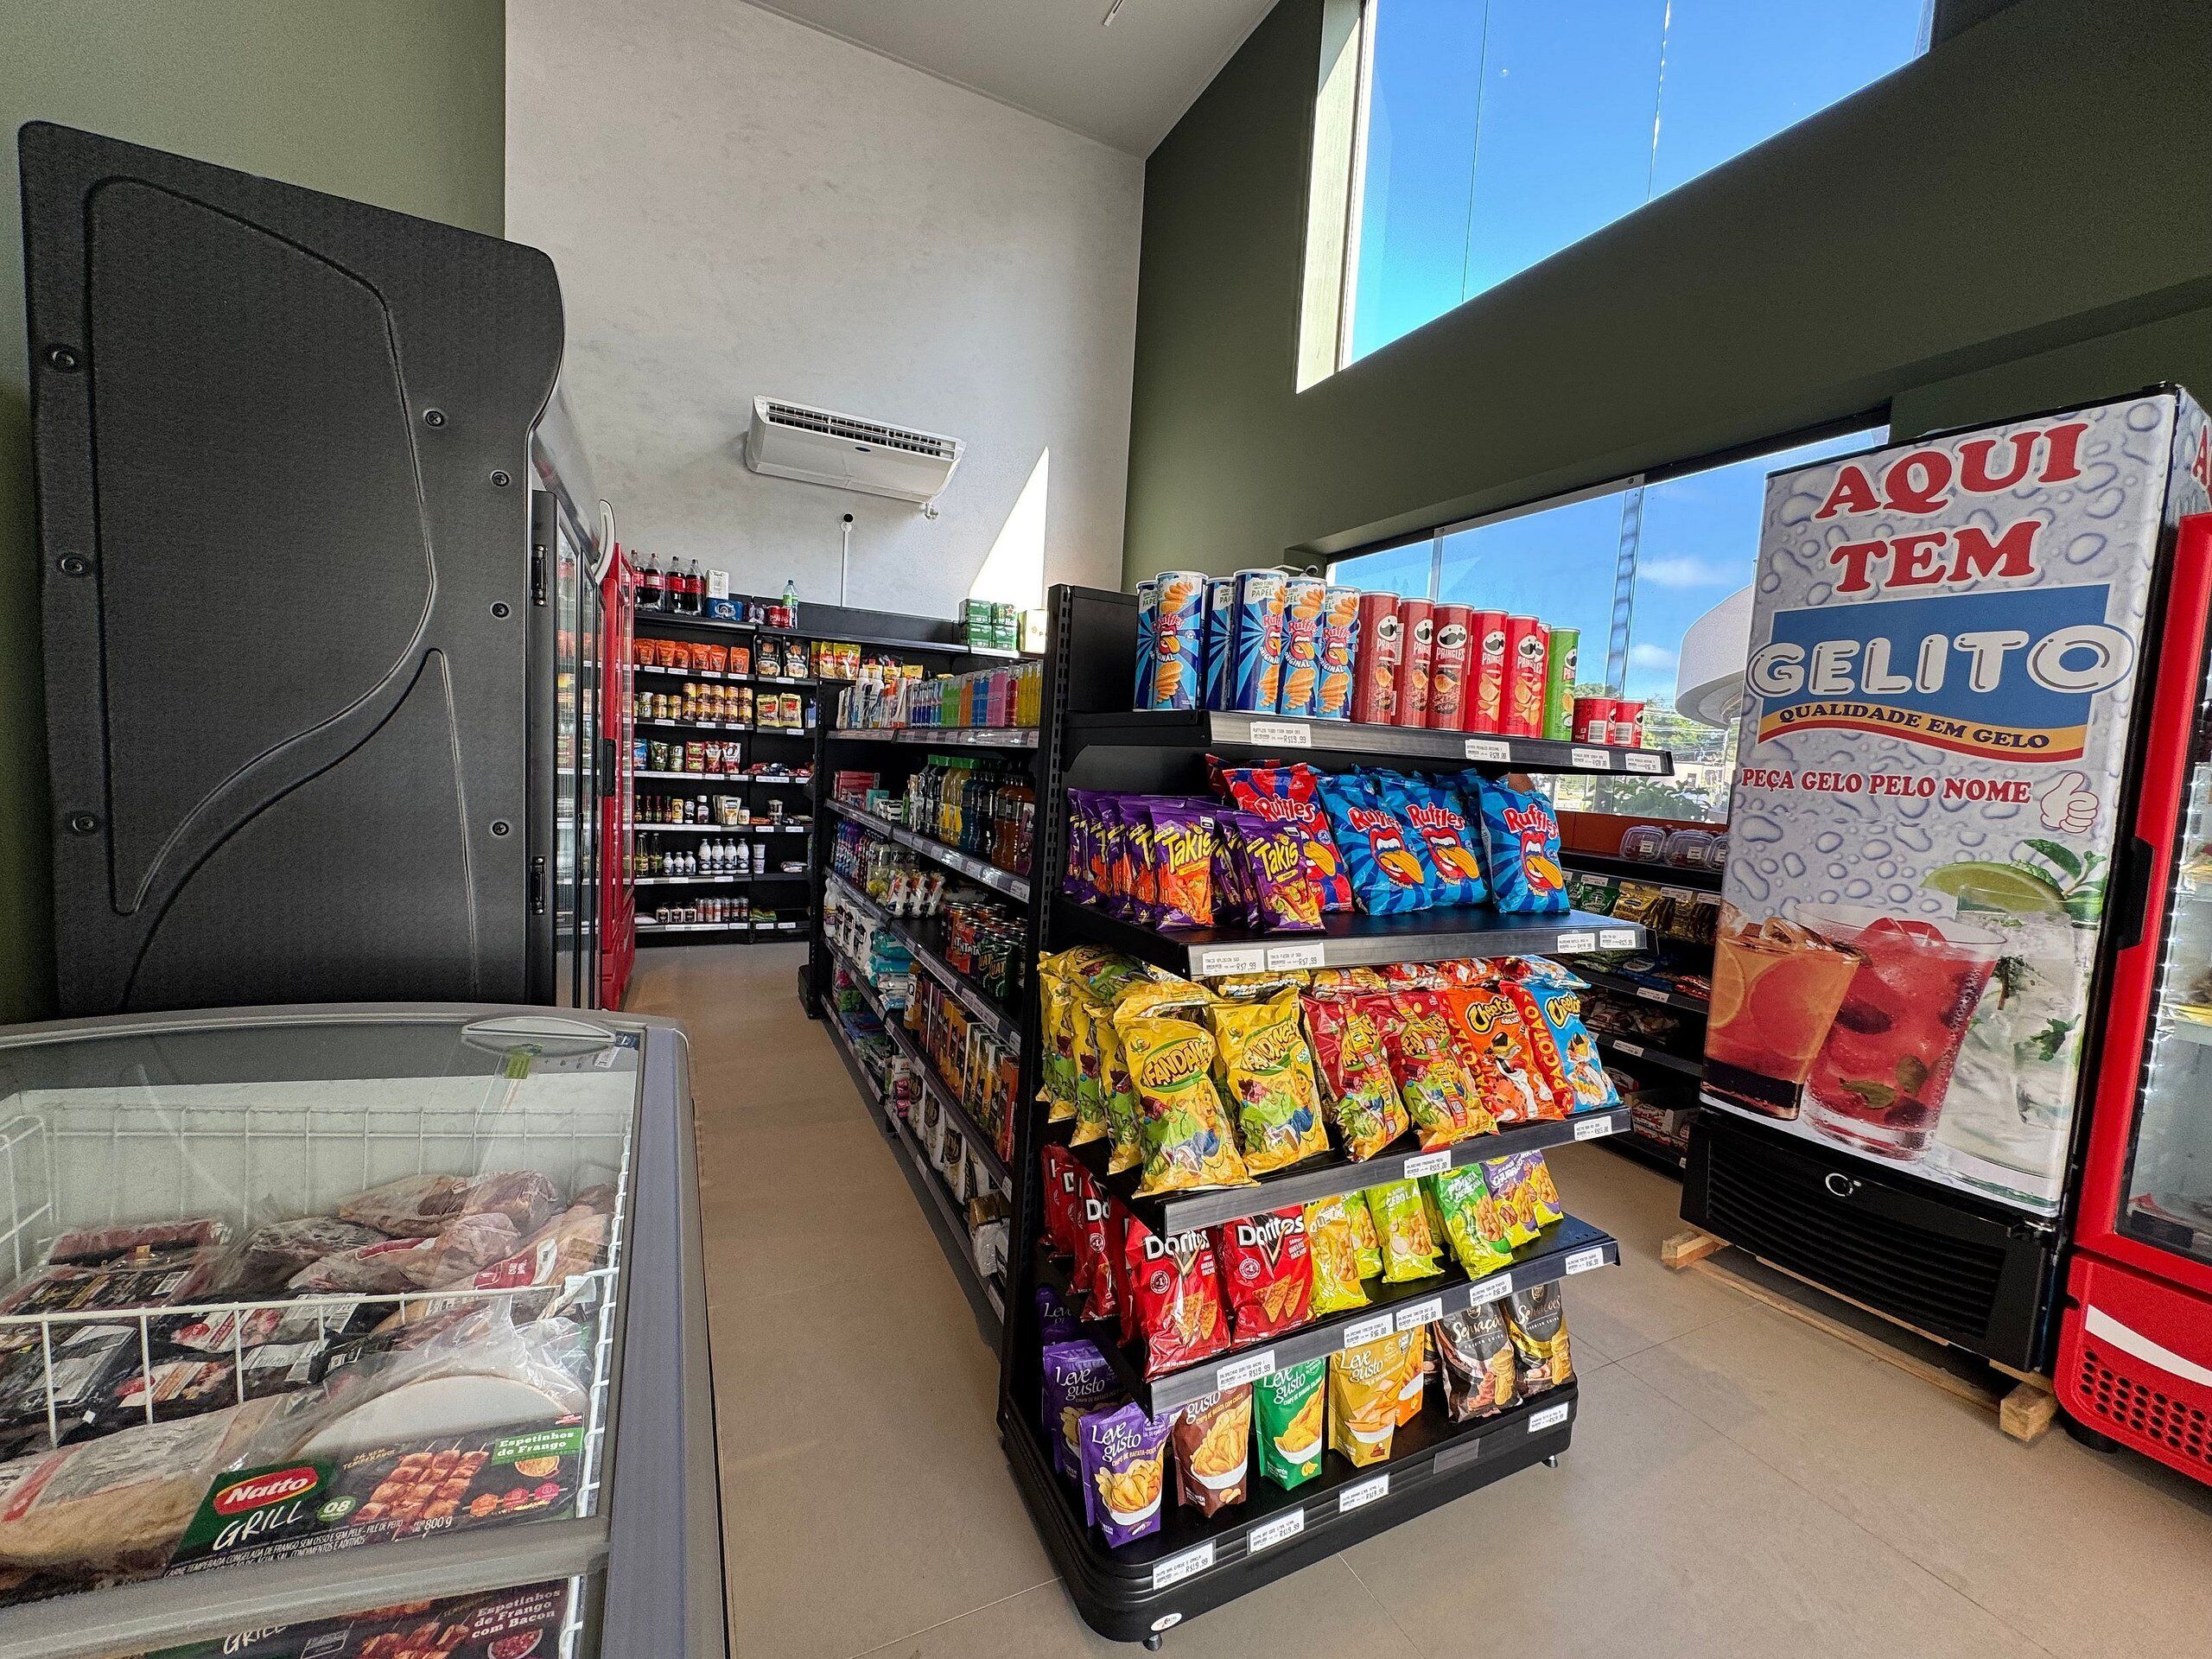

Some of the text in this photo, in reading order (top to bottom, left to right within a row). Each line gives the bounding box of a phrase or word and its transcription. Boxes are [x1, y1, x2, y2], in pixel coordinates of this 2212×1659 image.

[1815, 423, 2088, 519] AQUI
[1829, 520, 2042, 593] TEM
[1284, 652, 1311, 668] ORIGINAL
[1319, 658, 1344, 673] ORIGINAL
[1436, 646, 1465, 662] PRINGLES
[1750, 624, 2133, 698] GELITO
[1283, 735, 1306, 745] R$19,99
[1778, 703, 2050, 749] QUALIDADE EM GELO
[1741, 768, 2031, 804] PEÇA GELO PELO NOME
[1254, 793, 1316, 823] Ruffles
[1347, 806, 1405, 836] Ruffles
[1405, 802, 1465, 831] Ruffles
[1502, 804, 1559, 840] Ruffles
[1162, 830, 1211, 874] Takis
[1254, 841, 1299, 881] Takis
[1236, 962, 1256, 971] R$7,99
[1144, 1229, 1210, 1260] Doritos
[1237, 1215, 1305, 1246] Doritos
[1249, 1365, 1271, 1379] R$19,99
[1340, 1351, 1371, 1369] Leve
[1349, 1357, 1383, 1382] gusto
[1056, 1366, 1090, 1386] Leve
[1065, 1376, 1105, 1401] gusto
[1264, 1367, 1294, 1388] Leve
[1274, 1373, 1306, 1404] gusto
[1185, 1391, 1221, 1425] gusto
[499, 1432, 574, 1448] Espetinhos
[518, 1440, 567, 1454] Frango
[1091, 1421, 1127, 1446] Leve
[1102, 1428, 1141, 1462] gusto
[223, 1476, 308, 1505] Natto
[323, 1500, 349, 1514] 08
[213, 1501, 302, 1550] GRILL
[424, 1516, 452, 1530] 800 g
[1279, 1522, 1300, 1537] R$19,99
[164, 1565, 188, 1579] CARNE
[187, 1558, 226, 1573] TEMPERADA
[226, 1549, 264, 1565] CONGELADA
[264, 1546, 273, 1559] DE
[273, 1541, 299, 1556] FRANGO
[299, 1538, 312, 1548] SEM
[313, 1535, 328, 1547] OSSO
[334, 1531, 348, 1541] SEM
[347, 1527, 362, 1539] PELE
[378, 1521, 387, 1531] DE
[1185, 1557, 1208, 1574] R$19,99
[477, 1590, 560, 1618] Espetinhos
[498, 1601, 551, 1621] Frango
[472, 1610, 555, 1638] com Bacon
